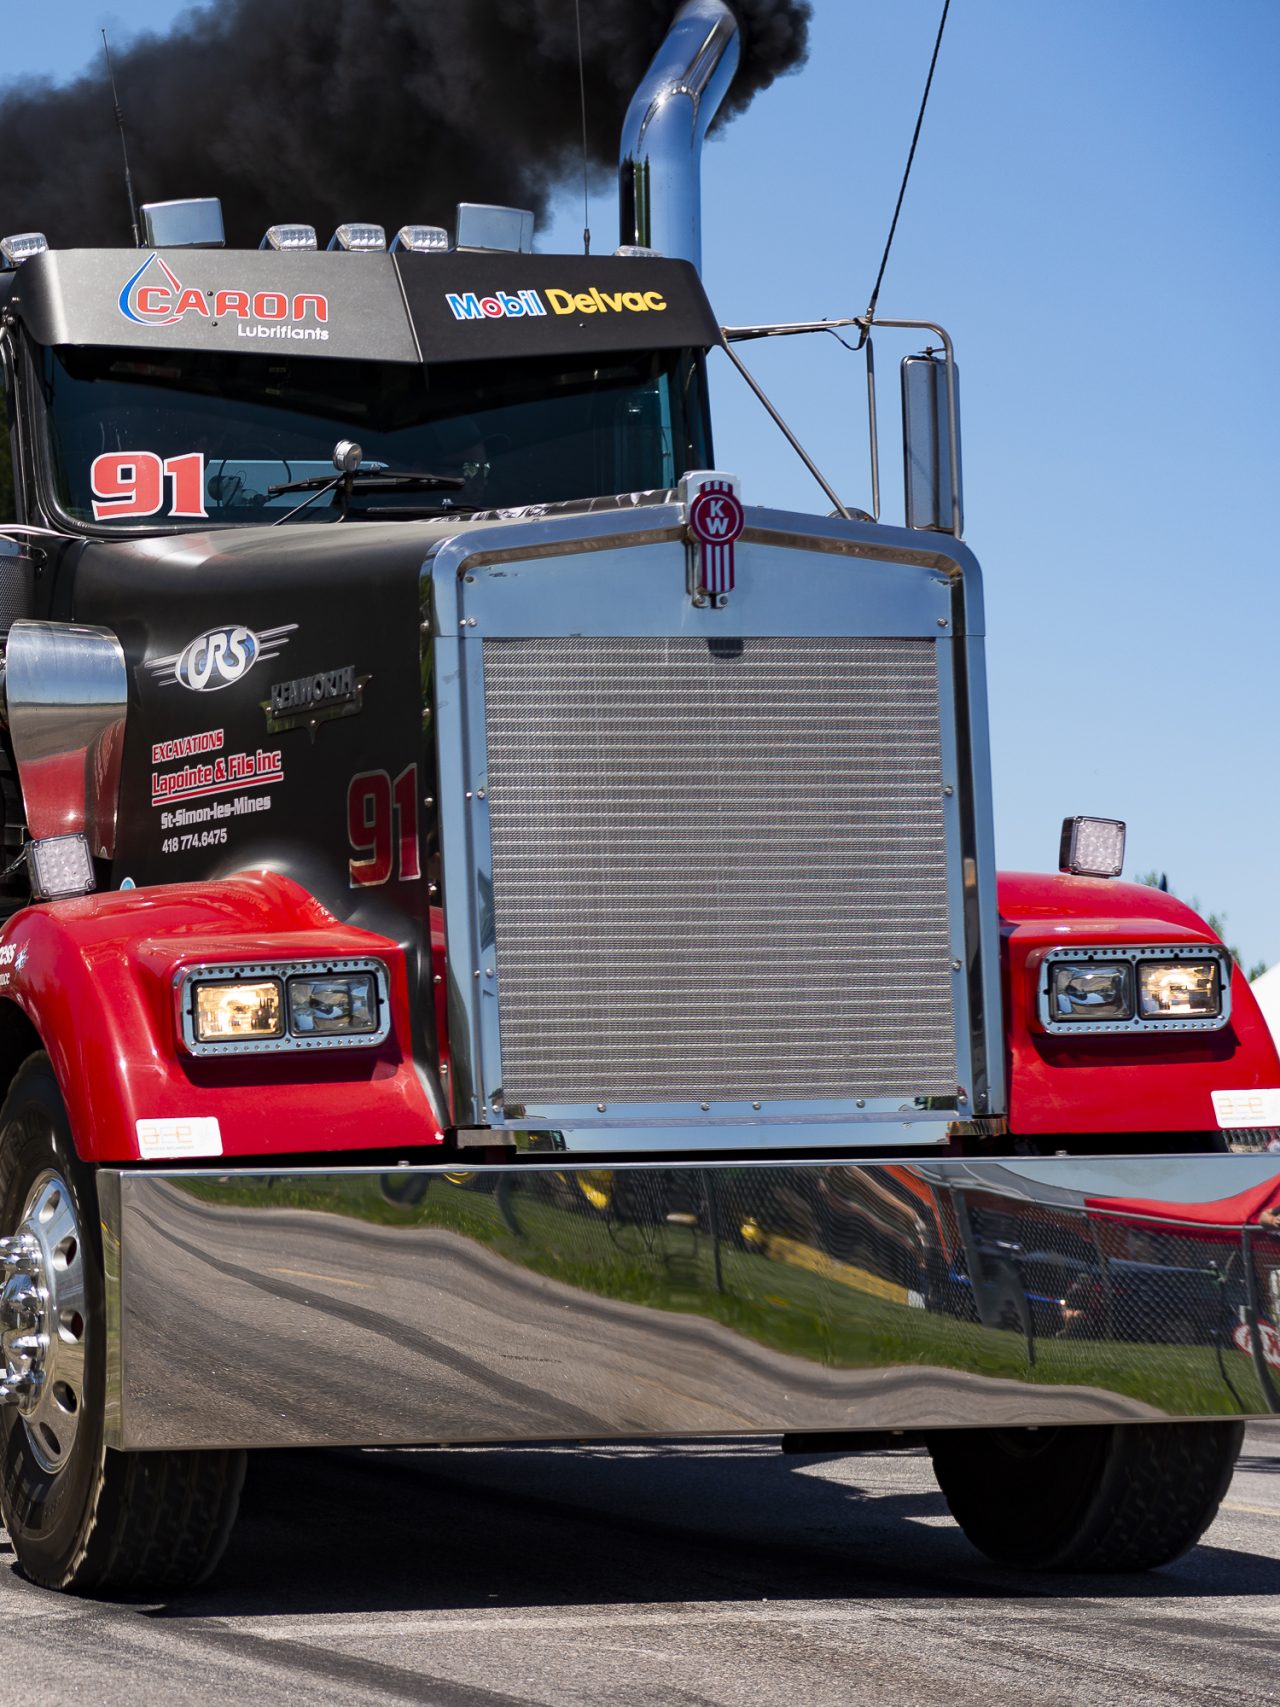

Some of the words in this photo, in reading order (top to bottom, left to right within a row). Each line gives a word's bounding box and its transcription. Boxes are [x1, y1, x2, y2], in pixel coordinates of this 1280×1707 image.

[136, 286, 329, 323] CARON
[445, 289, 548, 321] Mobil
[545, 287, 668, 315] Delvac
[237, 323, 330, 342] Lubrifiants
[90, 451, 210, 521] 91
[271, 665, 356, 711] KENWORTH
[151, 728, 225, 764] EXCAVATIONS
[151, 765, 213, 796] Lapointe
[214, 757, 226, 783] &
[228, 752, 255, 779] Fils
[256, 748, 282, 774] inc
[161, 796, 271, 829] St-Simon-les-Mines
[347, 763, 421, 888] 91
[162, 837, 179, 854] 418
[180, 828, 228, 851] 774.6475
